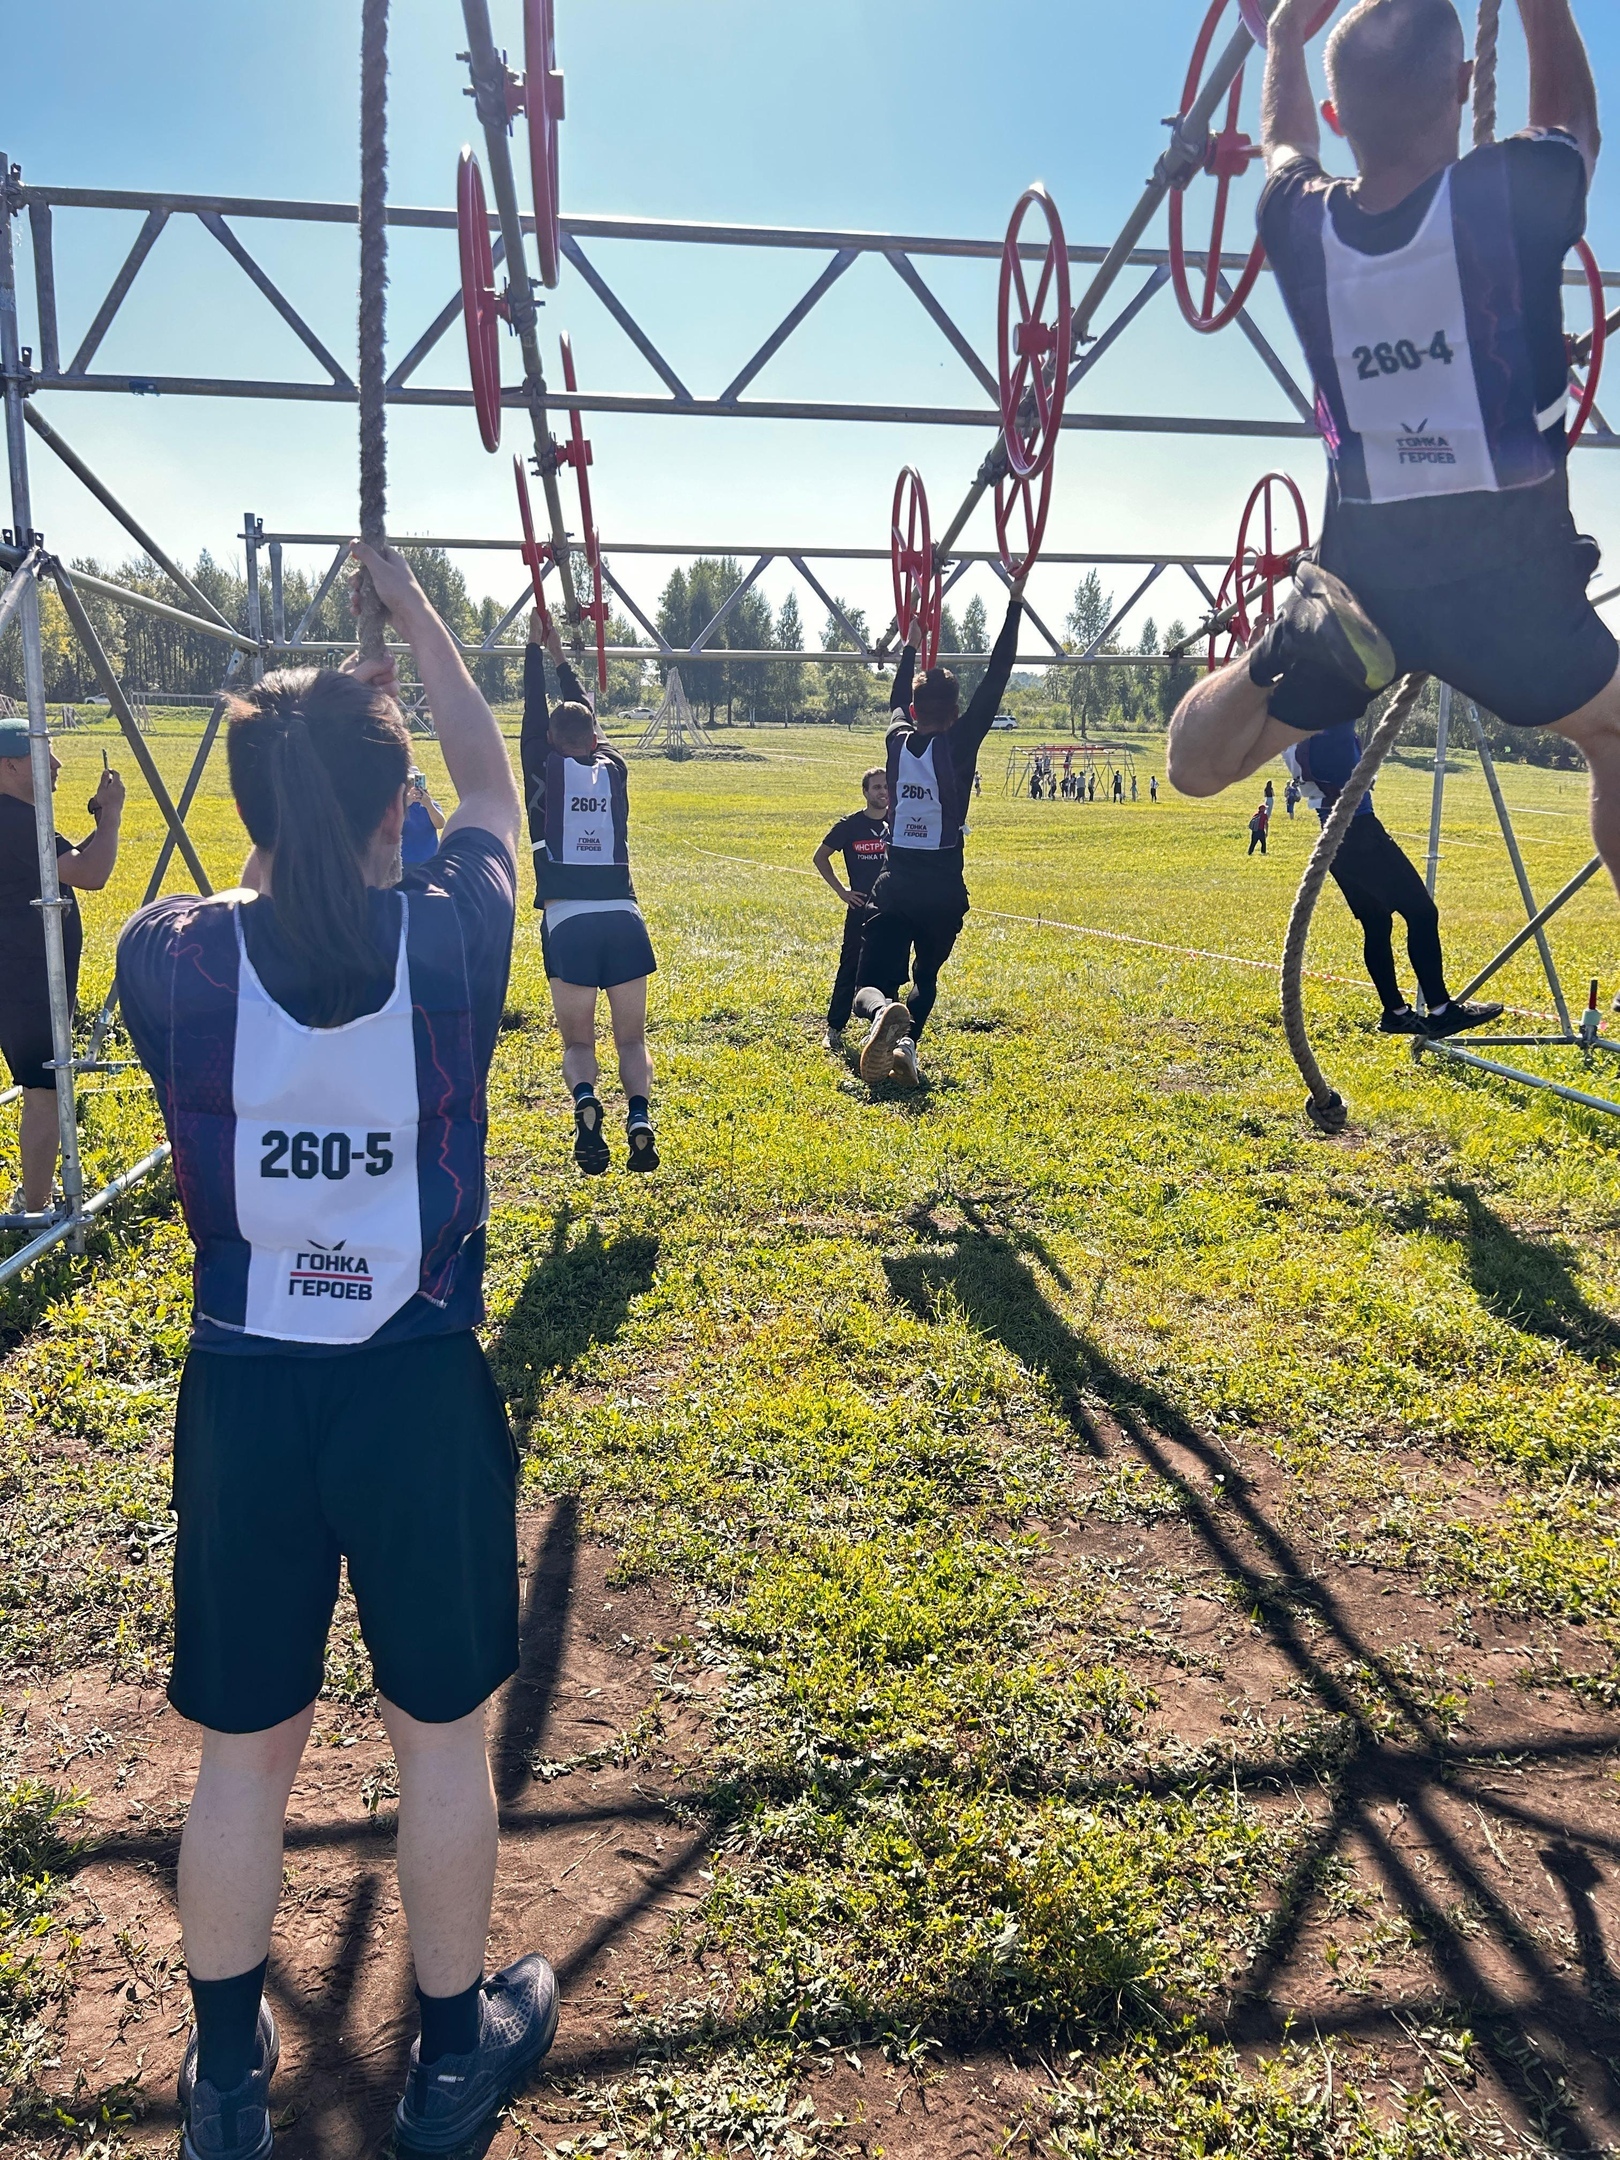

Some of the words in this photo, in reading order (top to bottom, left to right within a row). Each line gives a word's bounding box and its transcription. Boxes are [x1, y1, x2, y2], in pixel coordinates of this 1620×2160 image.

[1352, 329, 1454, 380] 260-4
[1395, 436, 1449, 447] ГОНКА
[1399, 451, 1456, 464] ГЕРОЕВ
[901, 784, 933, 801] 260-1
[571, 797, 607, 812] 260-2
[261, 1130, 393, 1180] 260-5
[296, 1252, 369, 1274] ГОНКА
[288, 1279, 373, 1301] ГЕРОЕВ
